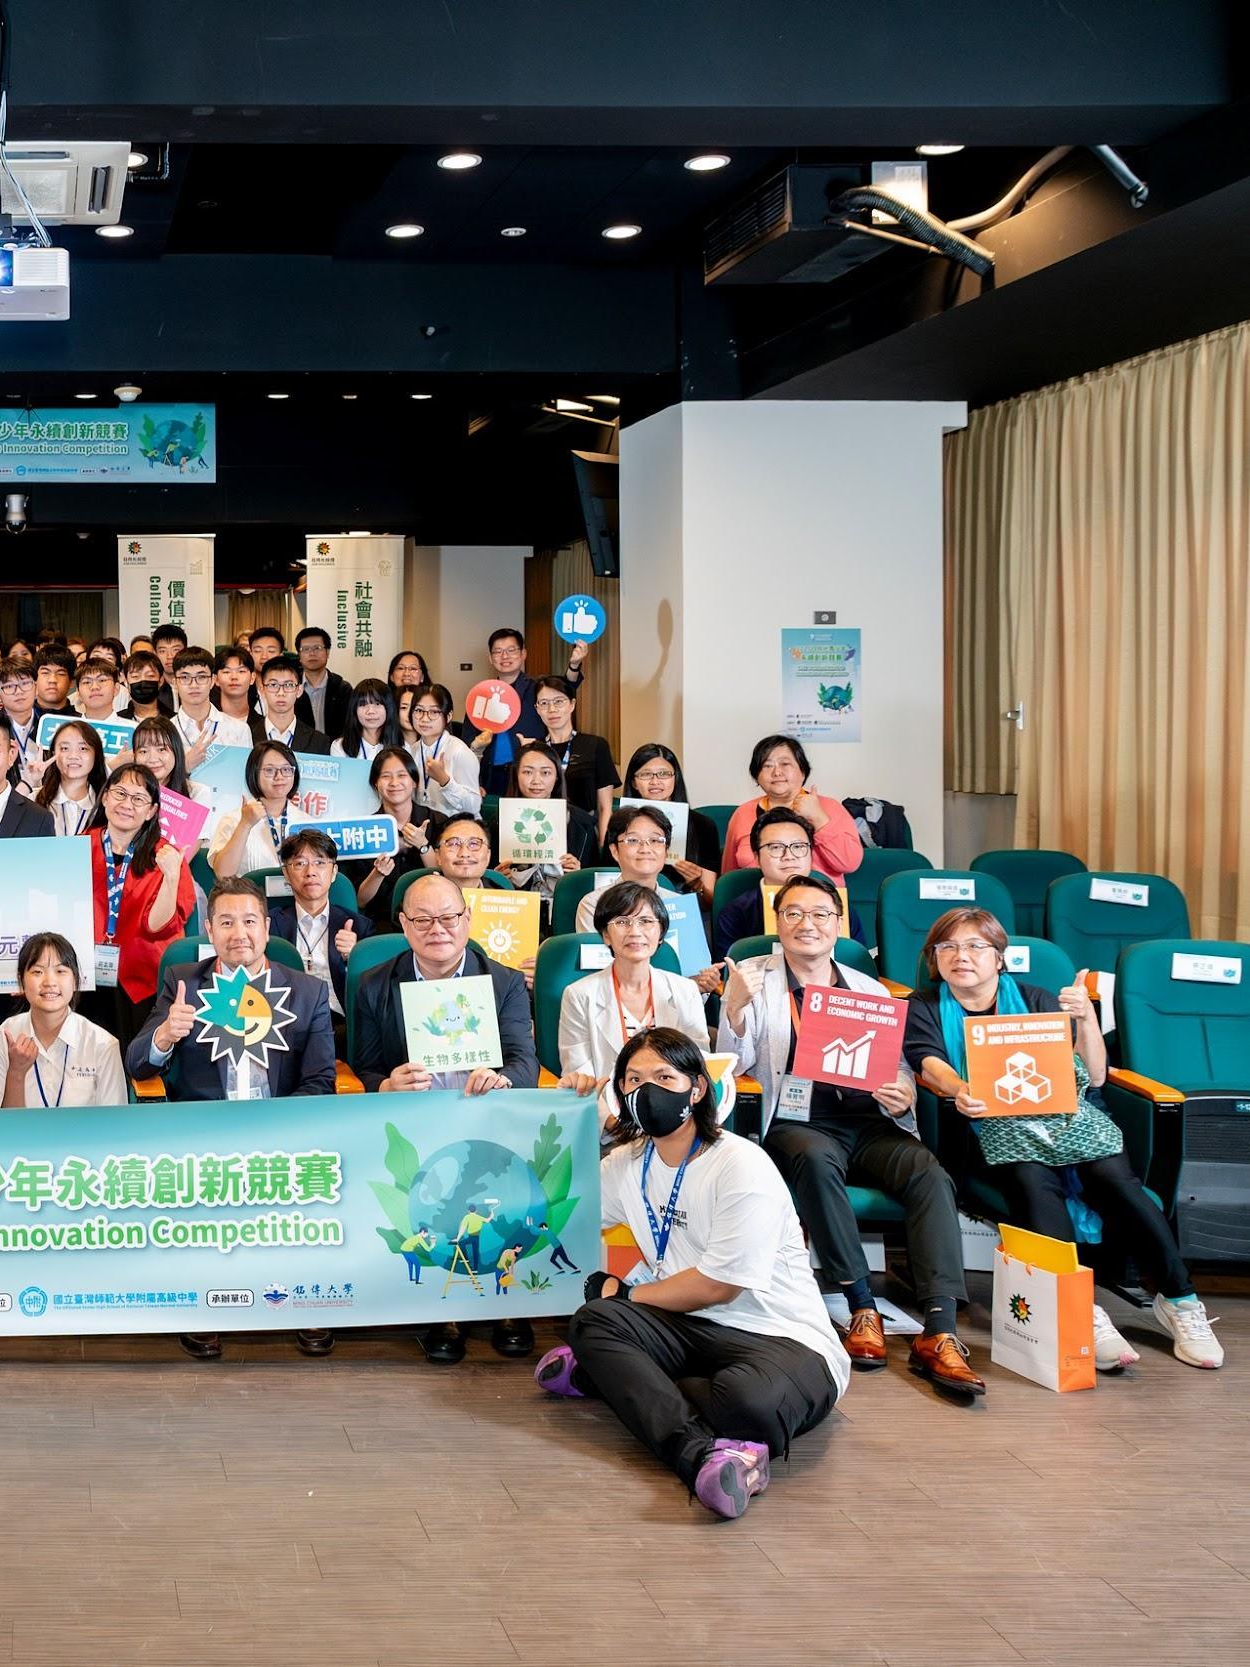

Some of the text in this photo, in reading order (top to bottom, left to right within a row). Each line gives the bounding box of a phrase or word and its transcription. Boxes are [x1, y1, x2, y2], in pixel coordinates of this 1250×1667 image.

[4, 442, 60, 453] Innovation
[62, 442, 127, 456] Competition
[337, 590, 349, 649] Inclusive
[354, 581, 373, 658] 社會共融
[325, 824, 388, 851] 大附中
[809, 991, 823, 1013] 8
[828, 995, 895, 1014] DECENT WORK AND
[827, 1006, 898, 1027] ECONOMIC GROWTH
[971, 1024, 985, 1046] 9
[423, 1050, 491, 1067] 生物多樣性
[152, 1214, 339, 1250] Competition
[211, 1293, 250, 1305] 承辦單位
[292, 1282, 354, 1296] 銘傳大學
